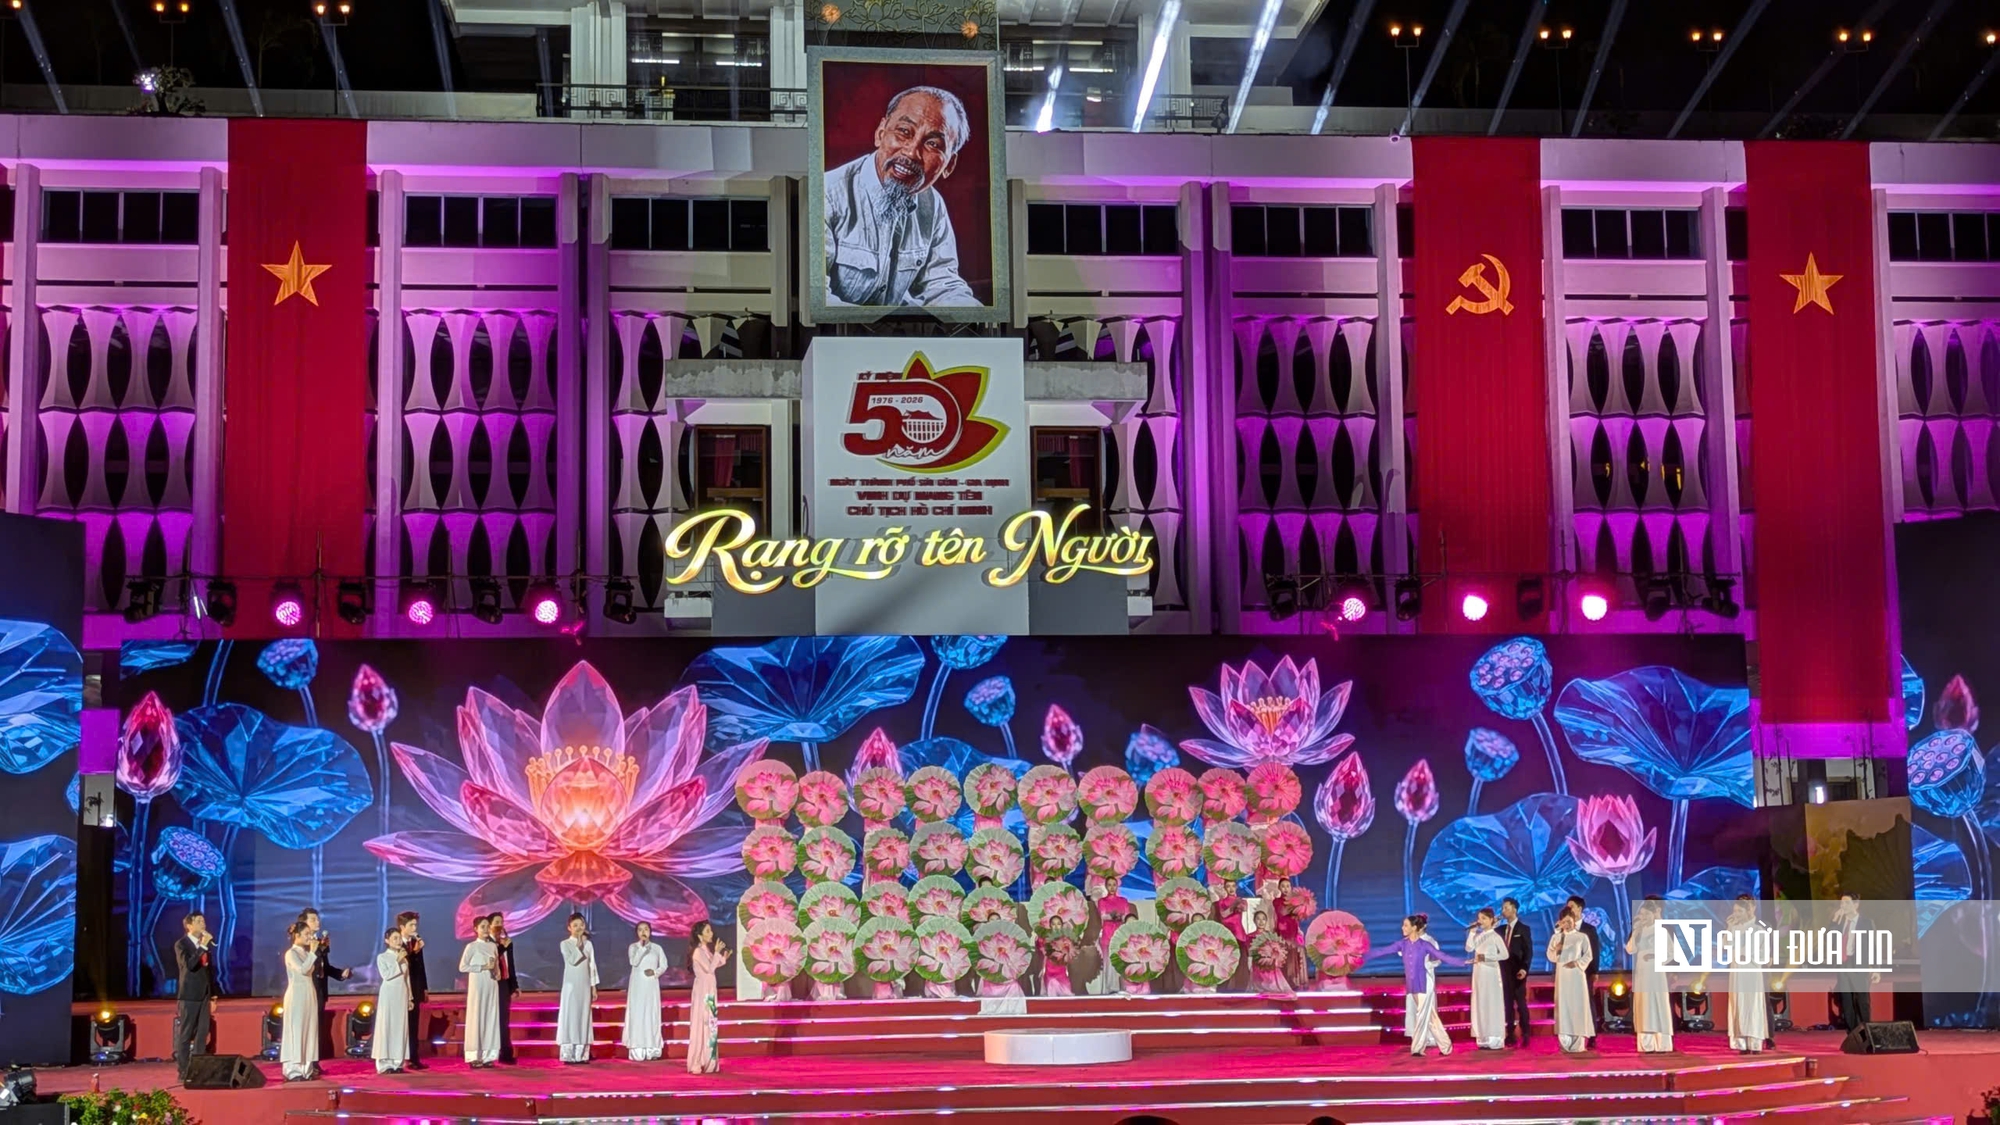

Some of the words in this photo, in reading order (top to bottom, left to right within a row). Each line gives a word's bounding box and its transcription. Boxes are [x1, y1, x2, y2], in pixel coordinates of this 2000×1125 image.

[871, 396, 894, 404] 1976
[900, 396, 924, 404] 2026
[886, 446, 944, 458] năm
[847, 503, 875, 515] CHỦ
[878, 506, 907, 517] TỊCH
[911, 502, 929, 515] HỒ
[932, 504, 954, 515] CHÍ
[957, 506, 993, 515] MINH
[665, 508, 892, 594] Rạng
[861, 526, 909, 566] rỡ
[921, 527, 987, 567] tên
[983, 503, 1154, 588] Người
